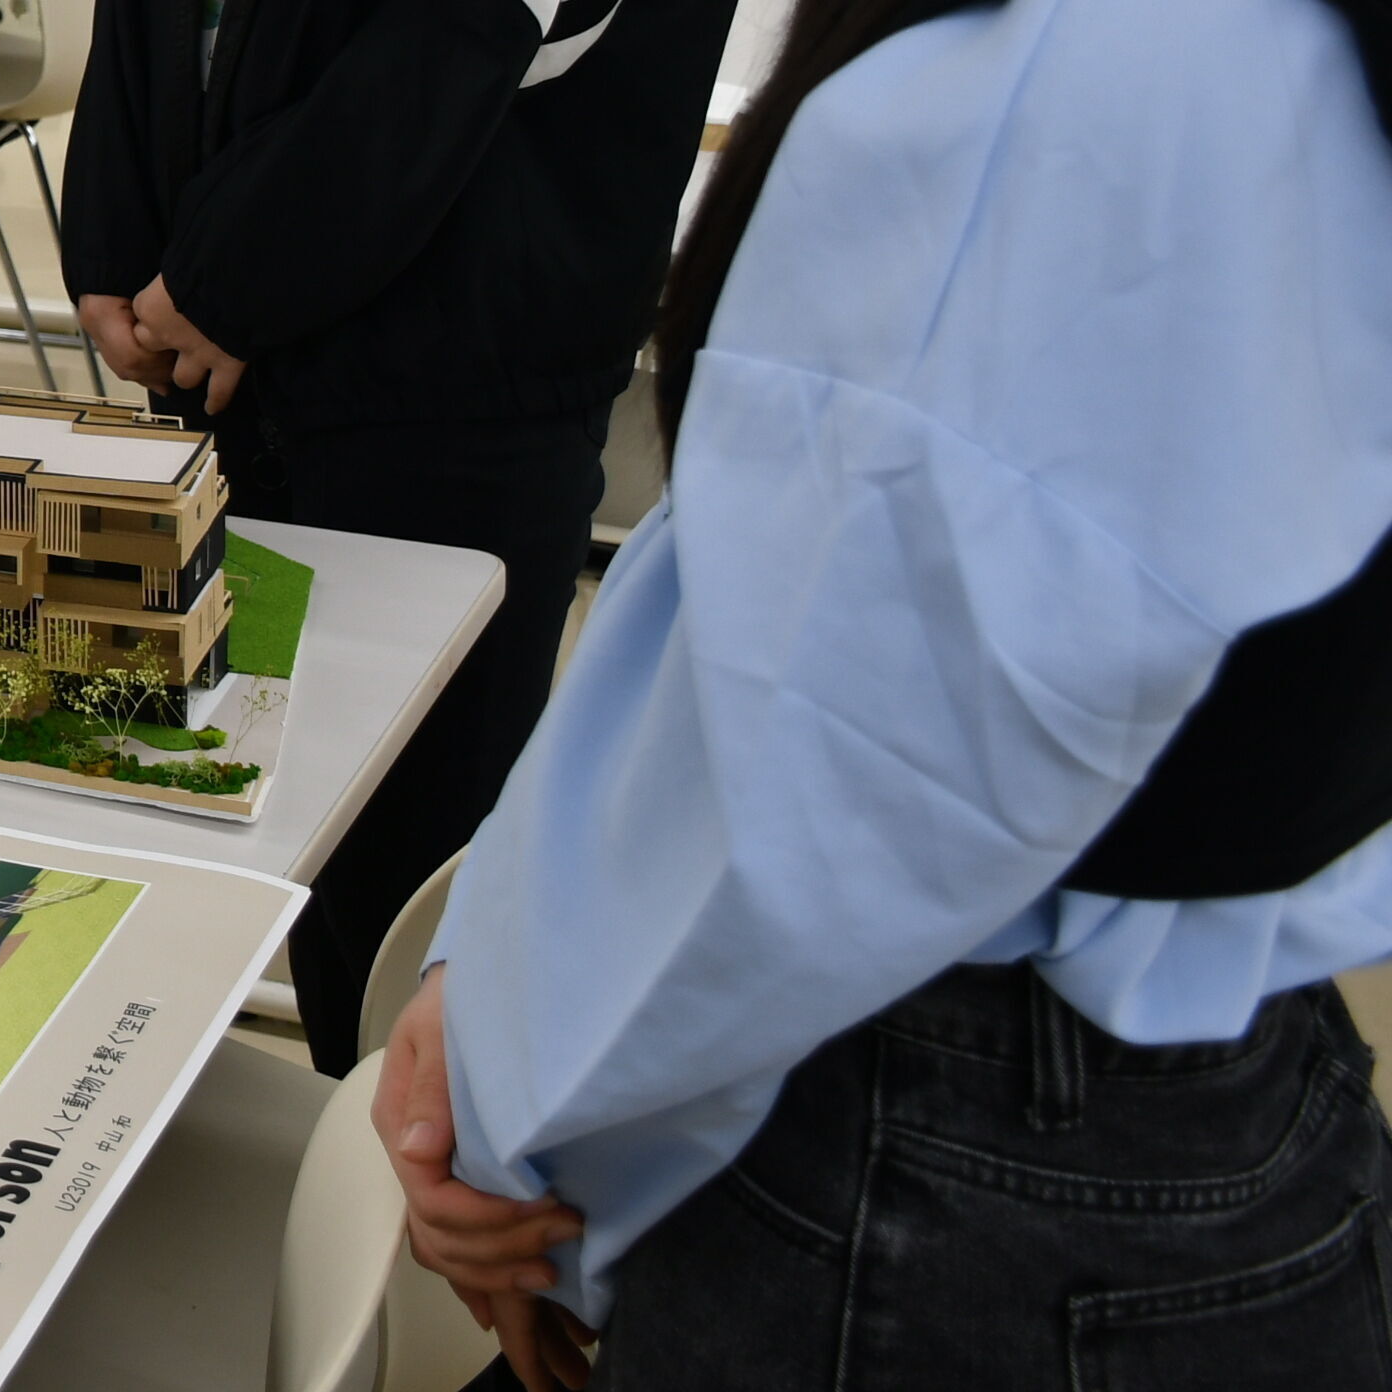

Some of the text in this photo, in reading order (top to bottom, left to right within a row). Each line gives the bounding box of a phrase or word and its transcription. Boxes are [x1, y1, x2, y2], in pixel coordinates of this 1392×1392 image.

[44, 1001, 157, 1143] 人と動物を繋ぐ空間
[54, 1160, 102, 1213] U23019
